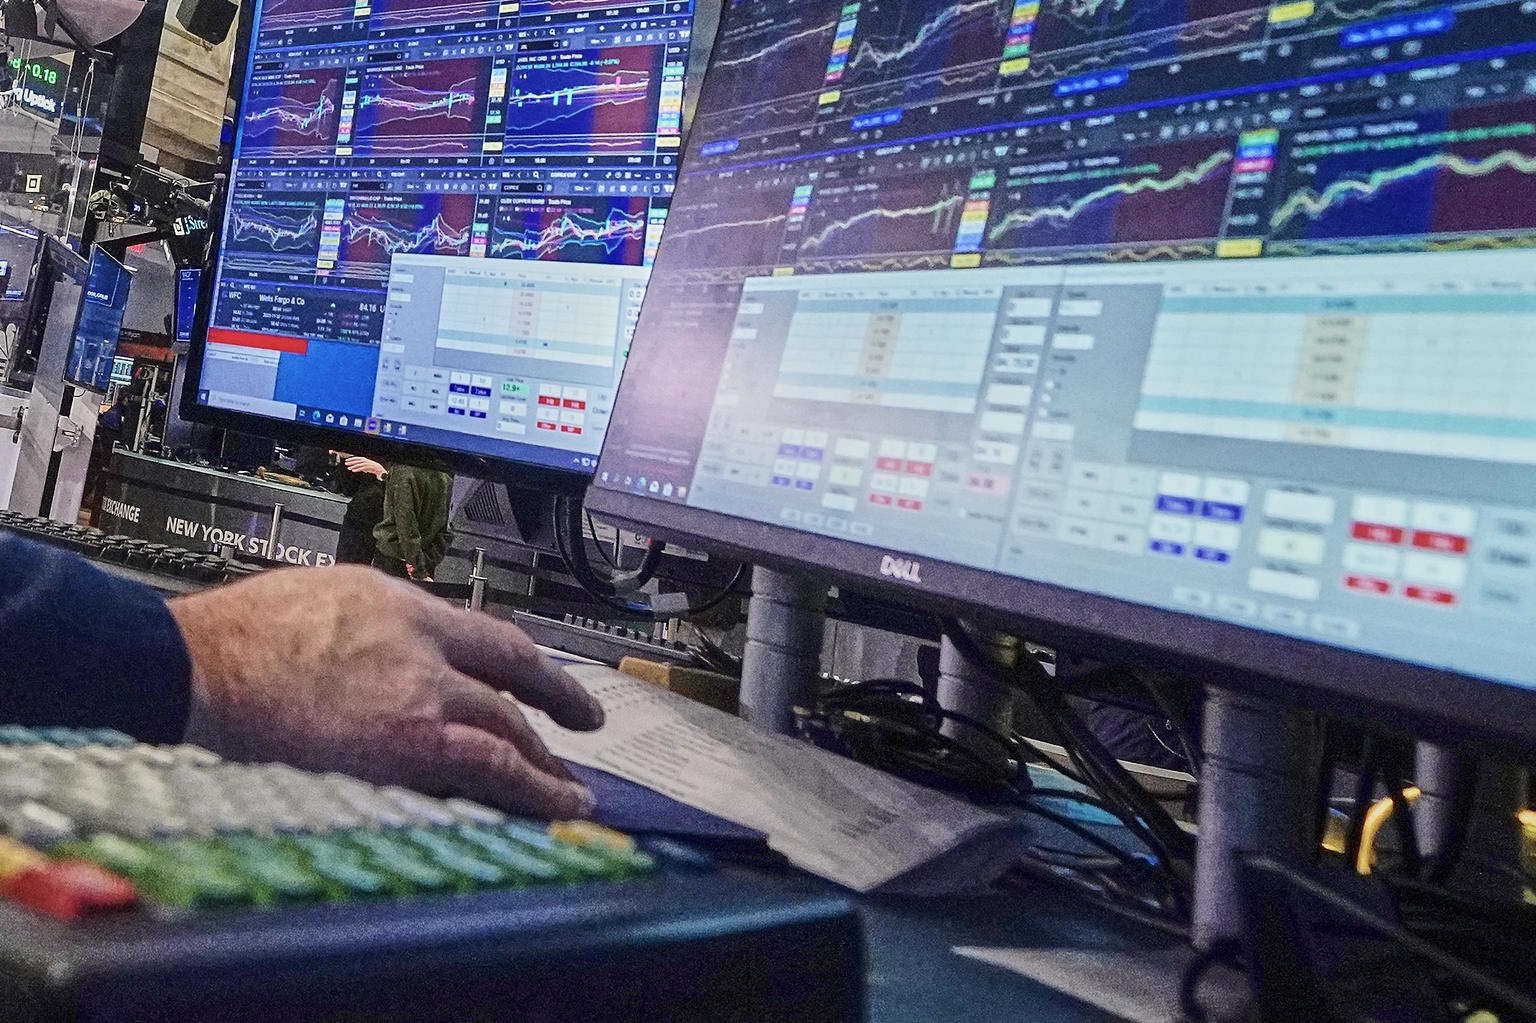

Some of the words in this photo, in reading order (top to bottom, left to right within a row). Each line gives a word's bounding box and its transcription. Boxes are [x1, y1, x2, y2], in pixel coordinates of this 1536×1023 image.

[32, 64, 57, 85] 0.18
[273, 294, 290, 306] Fargo
[166, 516, 199, 543] NEW
[201, 525, 247, 552] YORK
